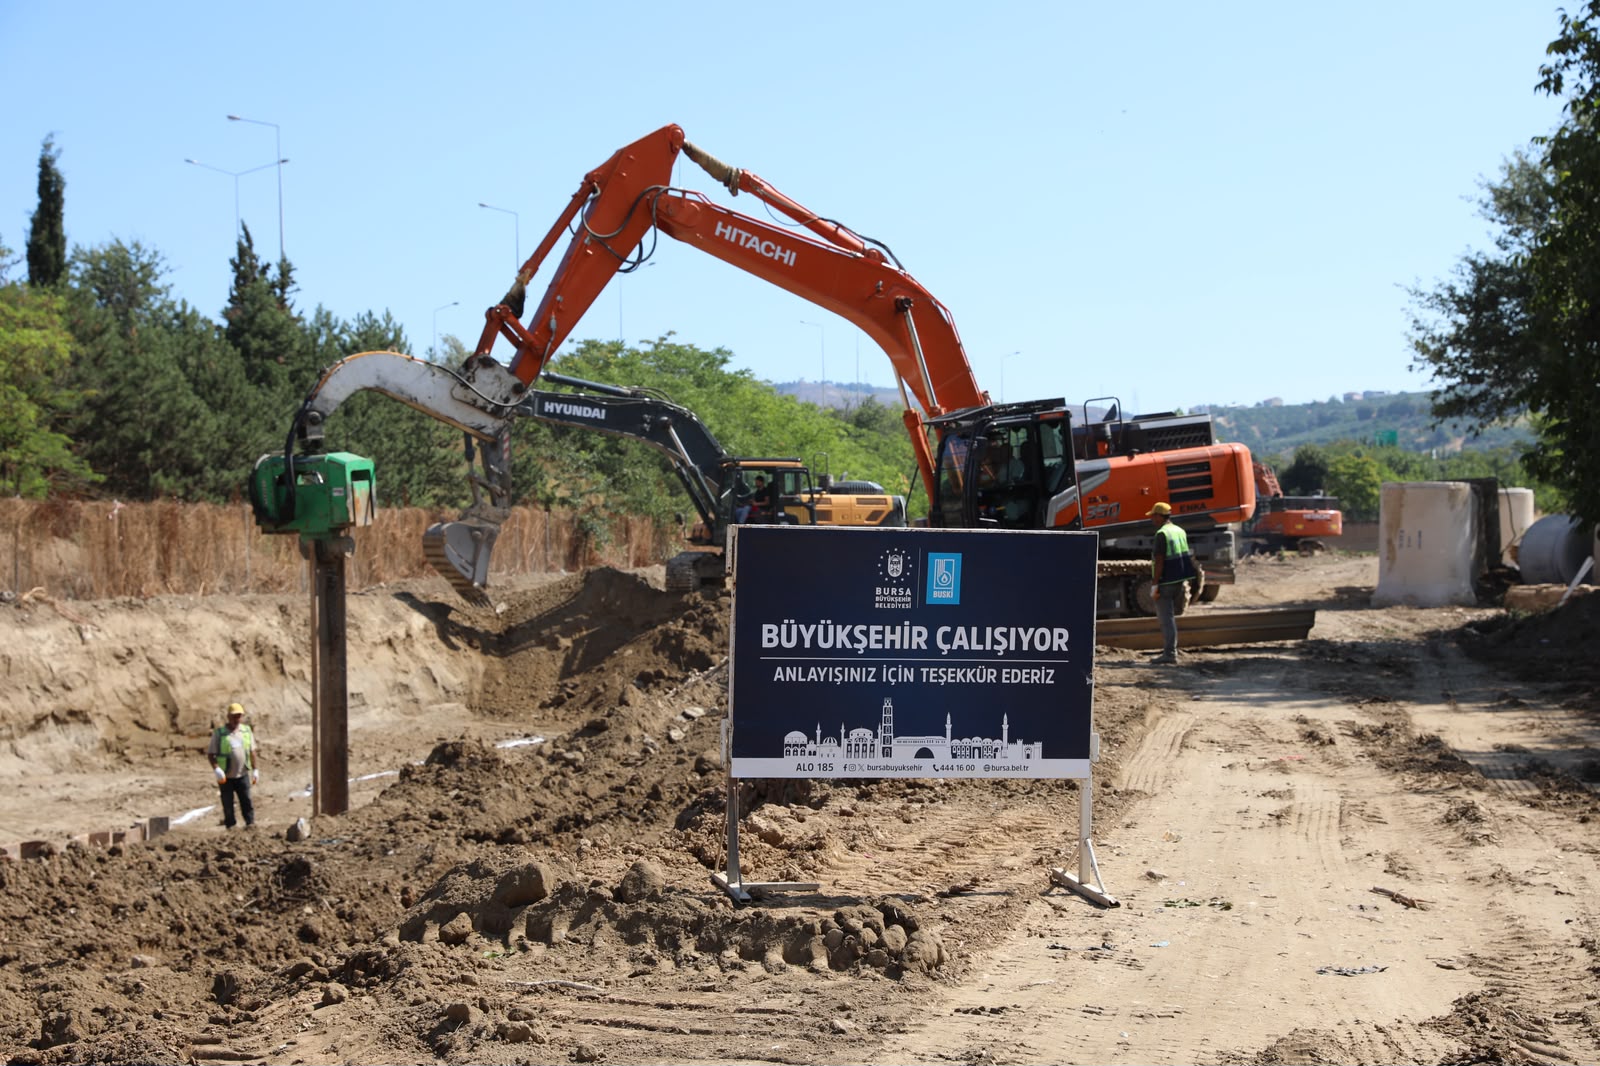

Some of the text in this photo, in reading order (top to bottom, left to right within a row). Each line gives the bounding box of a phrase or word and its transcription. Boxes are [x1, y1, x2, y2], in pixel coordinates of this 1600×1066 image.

[714, 221, 797, 267] HITACHI
[544, 401, 607, 420] HYUNDAI
[1086, 501, 1121, 521] 350
[875, 587, 912, 596] BURSA
[875, 595, 912, 603] BÜYÜKŞEHİR
[761, 619, 1069, 656] BÜYÜKŞEHİR ÇALIŞIYOR
[773, 665, 1055, 686] ANLAYIŞINIZ İÇİN TEŞEKKÜR EDERİZ
[795, 763, 834, 772] ALO 185
[866, 763, 923, 773] bursabuyuksehir
[939, 764, 976, 772] 444 16 00
[991, 764, 1029, 772] bursa.bel.tr
